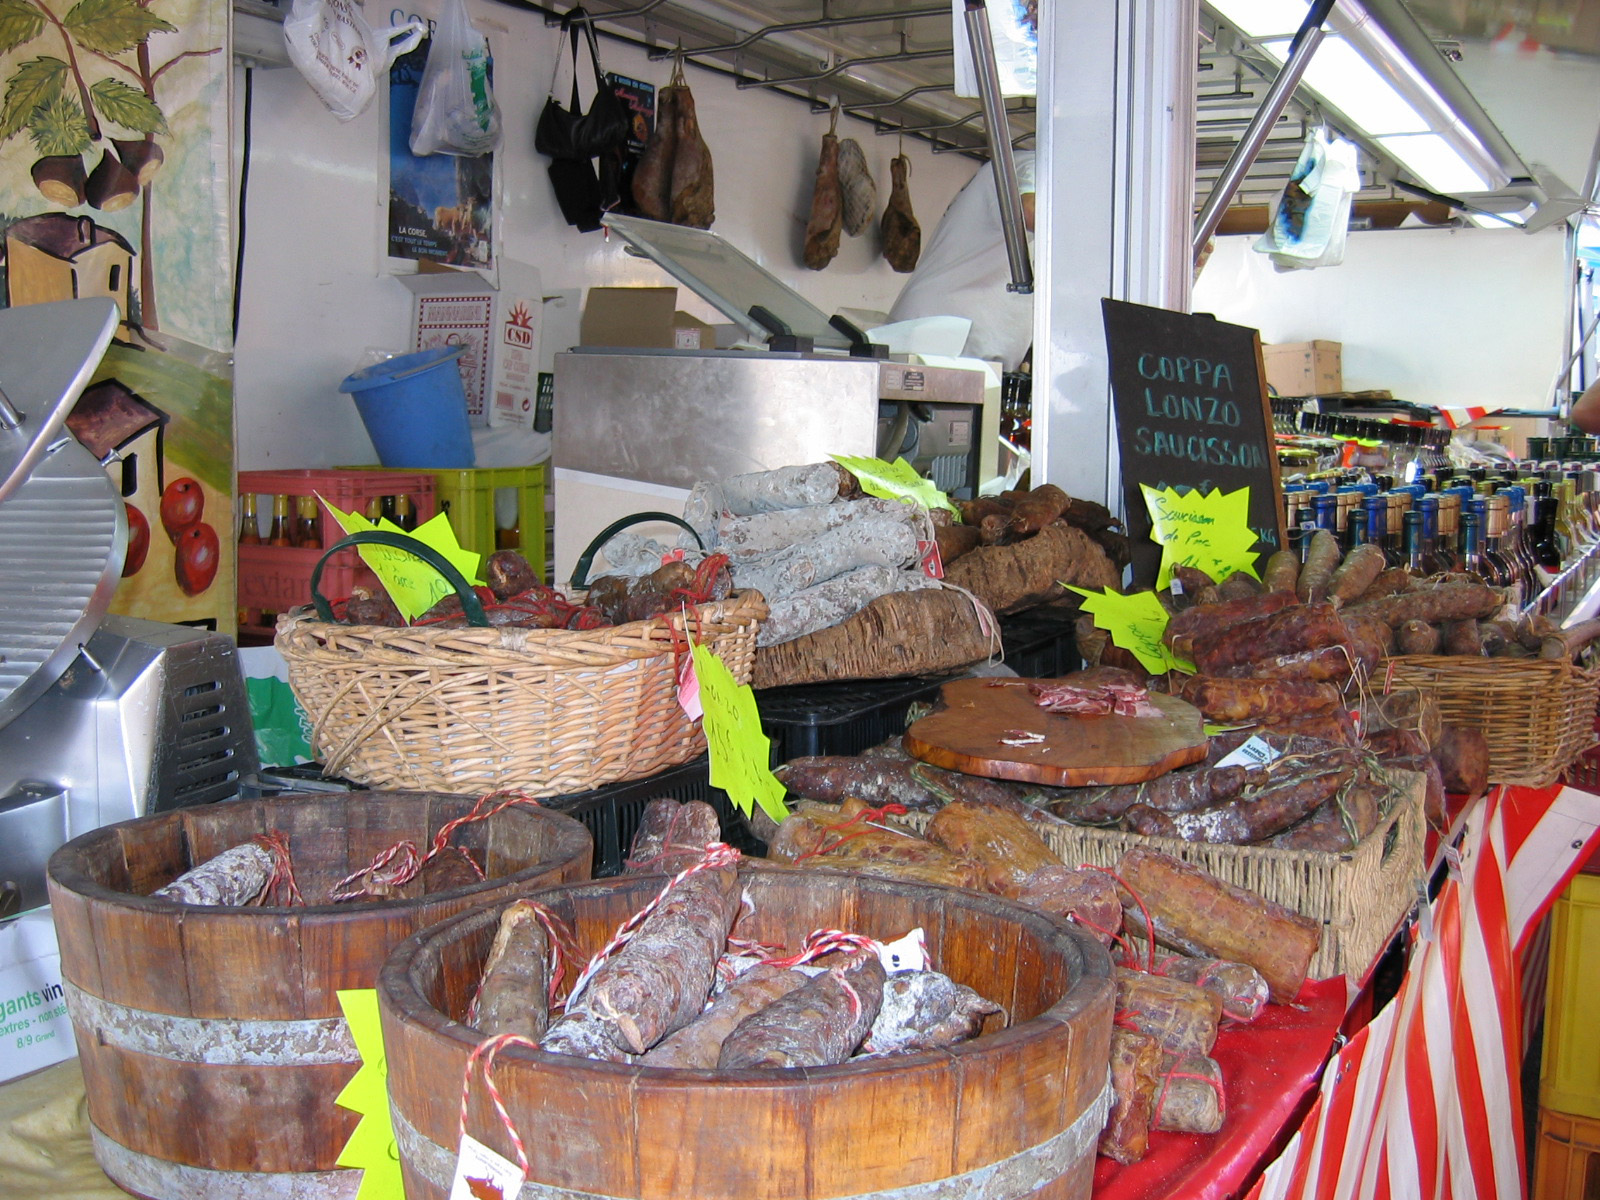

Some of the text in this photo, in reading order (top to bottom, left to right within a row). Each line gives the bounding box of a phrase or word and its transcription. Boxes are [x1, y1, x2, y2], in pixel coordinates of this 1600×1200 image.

[398, 226, 406, 234] LA
[507, 328, 531, 345] CSD
[1138, 353, 1233, 392] COPPA
[1145, 387, 1241, 427] LONZO
[1135, 426, 1267, 468] SAUCISSON
[1164, 528, 1179, 541] de
[0, 982, 64, 1024] gants vin
[0, 1018, 30, 1037] extres
[38, 1010, 54, 1024] non
[53, 1002, 68, 1017] sté
[17, 1034, 33, 1049] 8/9
